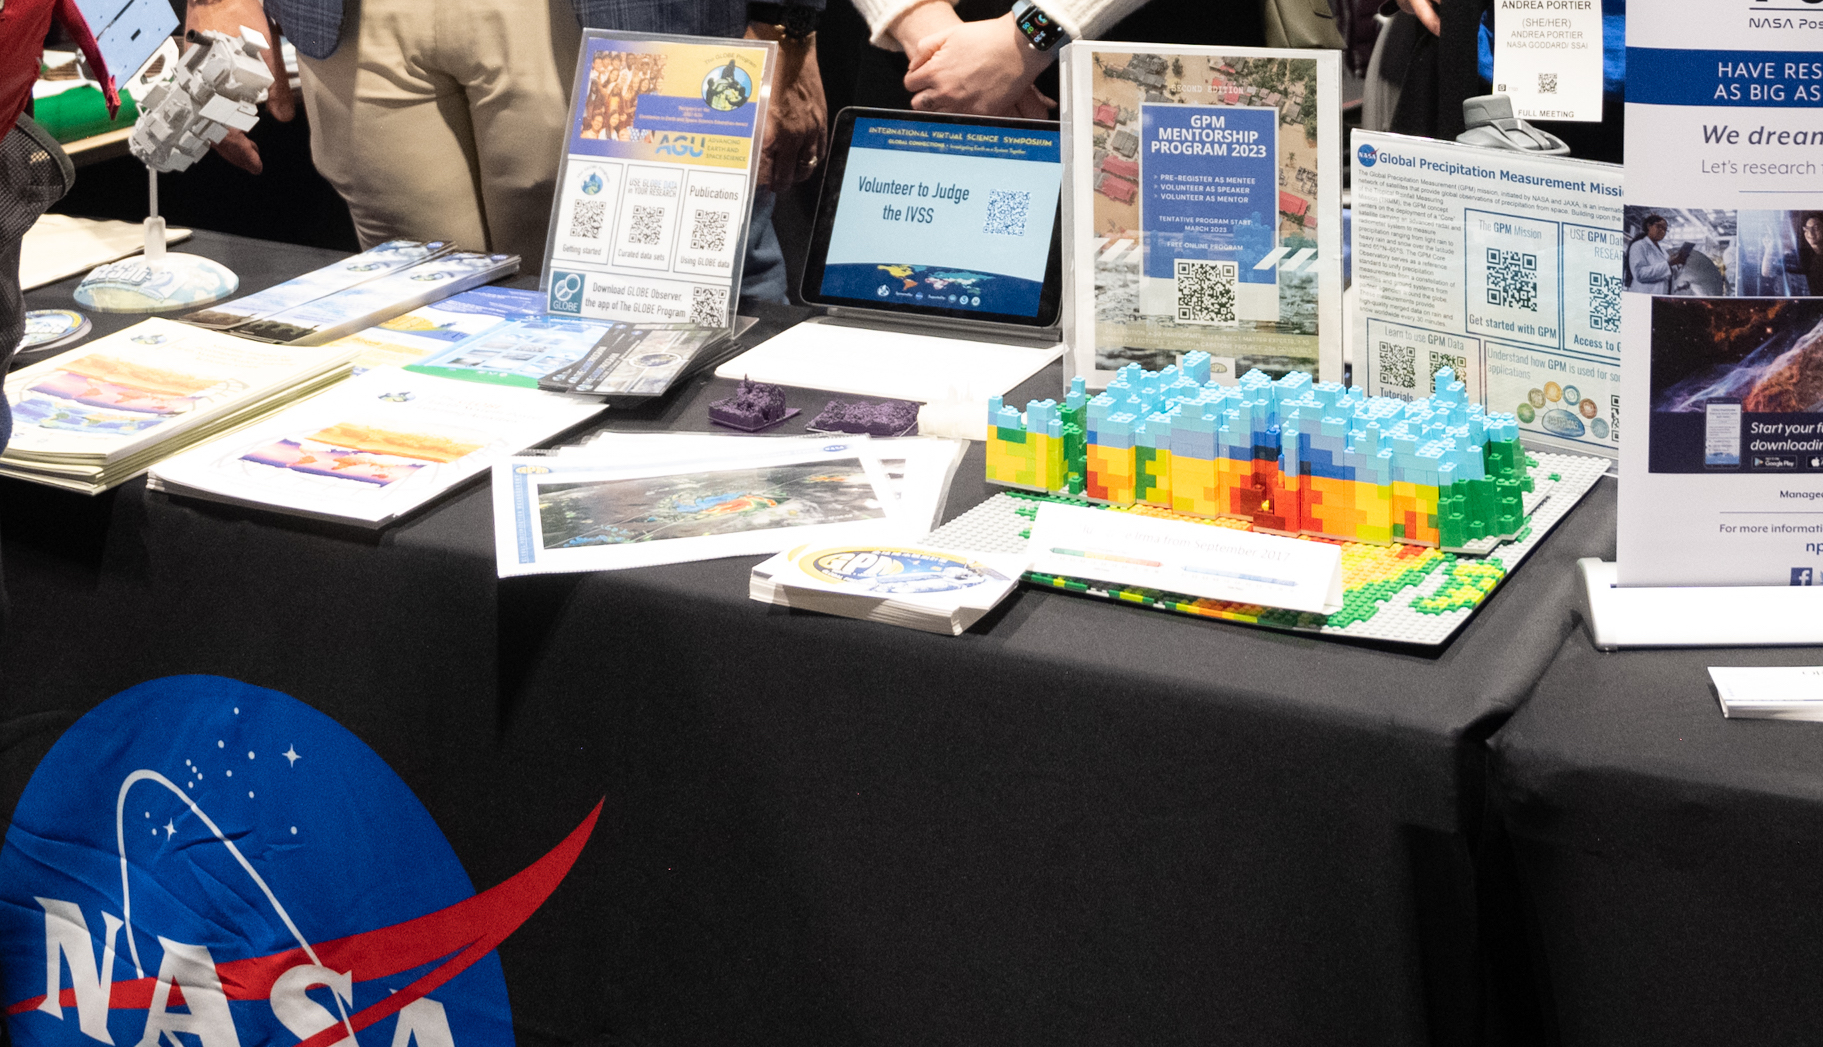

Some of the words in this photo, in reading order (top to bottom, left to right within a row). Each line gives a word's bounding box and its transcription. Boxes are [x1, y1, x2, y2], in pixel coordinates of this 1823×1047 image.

[1502, 1, 1544, 9] ANDREA
[1547, 1, 1592, 10] PORTIER
[1522, 18, 1572, 29] (SHE/HER)
[1749, 18, 1794, 29] NASA
[1511, 31, 1545, 39] ANDREA
[1547, 31, 1583, 39] PORTIER
[1718, 62, 1775, 79] HAVE
[1785, 63, 1823, 79] RES
[1171, 84, 1202, 93] SECOND
[1208, 86, 1244, 94] EDITION
[1714, 83, 1741, 99] AS
[1750, 85, 1785, 101] BIG
[1794, 85, 1821, 101] AS
[1518, 109, 1536, 117] FULL
[1540, 110, 1574, 118] MEETING
[1190, 115, 1225, 129] GPM
[868, 127, 928, 138] INTERNATIONAL
[932, 132, 963, 141] VIRTUAL
[966, 133, 998, 143] SCIENCE
[1004, 136, 1052, 146] SYMPOSIUM
[1158, 127, 1258, 143] MENTORSHIP
[1703, 125, 1740, 144] We
[655, 135, 706, 157] AGU
[1151, 141, 1227, 156] PROGRAM
[1231, 145, 1266, 158] 2023
[1379, 152, 1415, 167] Global
[1419, 158, 1494, 182] Precipitation
[1499, 169, 1585, 192] Measurement
[1590, 181, 1622, 197] Missi
[1702, 159, 1738, 174] Let's
[1743, 160, 1816, 175] research
[630, 178, 640, 186] USE
[642, 179, 662, 188] GLOBE
[1160, 174, 1212, 183] PRE-REGISTER
[634, 187, 649, 195] YOUR
[650, 187, 677, 198] RESEARCH
[690, 185, 738, 201] Publications
[858, 175, 915, 195] Volunteer
[917, 182, 929, 197] to
[932, 183, 970, 204] Judge
[1160, 184, 1204, 192] VOLUNTEER
[1217, 186, 1250, 194] SPEAKER
[1160, 193, 1204, 201] VOLUNTEER
[882, 205, 901, 221] the
[905, 206, 934, 223] IVSS
[1159, 215, 1194, 223] TENTATIVE
[1195, 217, 1229, 225] PROGRAM
[1479, 219, 1491, 231] The
[1493, 222, 1511, 234] GPM
[1514, 225, 1541, 239] Mission
[1570, 228, 1585, 240] USE
[1587, 230, 1606, 244] GPM
[562, 244, 581, 255] Getting
[582, 246, 602, 257] started
[1209, 243, 1243, 251] PROGRAM
[618, 249, 639, 259] Curated
[640, 251, 652, 260] data
[654, 253, 665, 261] sets
[680, 256, 696, 267] Using
[697, 257, 716, 267] GLOBE
[717, 258, 730, 268] data
[593, 282, 626, 296] Download
[627, 285, 649, 298] GLOBE
[553, 300, 578, 312] GLOBE
[585, 297, 597, 308] the
[598, 301, 610, 311] app
[611, 299, 619, 310] of
[620, 301, 632, 312] The
[633, 303, 655, 315] GLOBE
[657, 305, 686, 319] Program
[1469, 313, 1482, 326] Get
[1485, 316, 1514, 331] started
[1517, 321, 1535, 335] with
[1537, 325, 1557, 339] GPM
[1384, 325, 1403, 339] Learn
[1406, 330, 1412, 340] to
[1413, 332, 1425, 343] use
[1427, 333, 1445, 346] GPM
[1447, 337, 1464, 350] Data
[1573, 333, 1602, 349] Access
[1605, 339, 1614, 351] to
[1487, 347, 1528, 365] Understand
[1530, 355, 1545, 368] how
[1547, 358, 1566, 372] GPM
[1568, 362, 1575, 374] is
[1576, 364, 1594, 377] used
[1597, 367, 1608, 380] for
[1487, 361, 1530, 381] applications
[1380, 387, 1414, 402] Tutorials
[1750, 422, 1783, 434] Start
[1785, 423, 1815, 437] your
[1765, 459, 1783, 467] Google
[1784, 460, 1794, 468] Play
[1720, 524, 1737, 533] For
[1739, 525, 1768, 533] more
[1135, 531, 1162, 544] Irma
[1164, 535, 1190, 549] from
[1195, 539, 1255, 558] September
[1261, 549, 1291, 562] 2017
